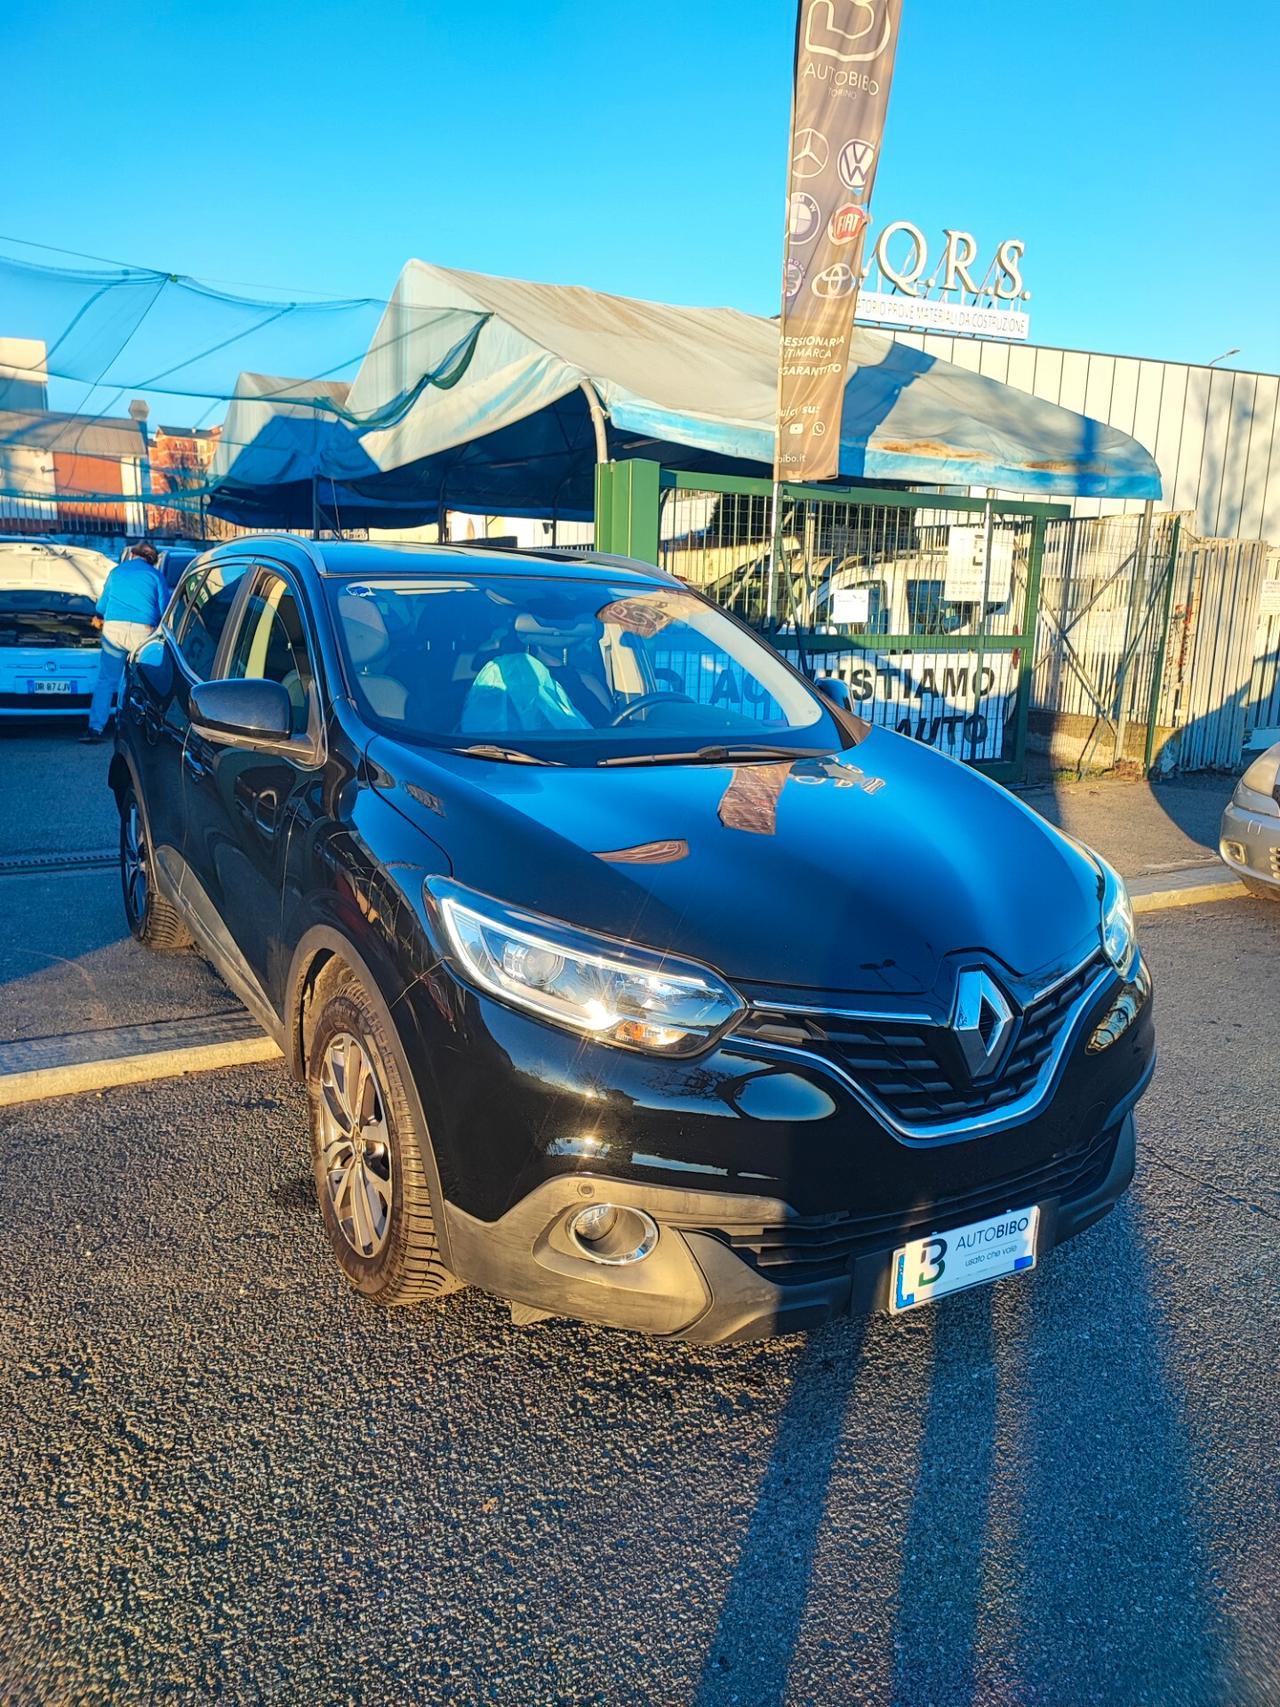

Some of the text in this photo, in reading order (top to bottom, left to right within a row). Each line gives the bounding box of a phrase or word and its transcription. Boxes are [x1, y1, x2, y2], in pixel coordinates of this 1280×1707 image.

[804, 62, 879, 95] AUTOBIBO
[837, 212, 861, 233] FIAT
[955, 1217, 1029, 1251] AUTOBIBO
